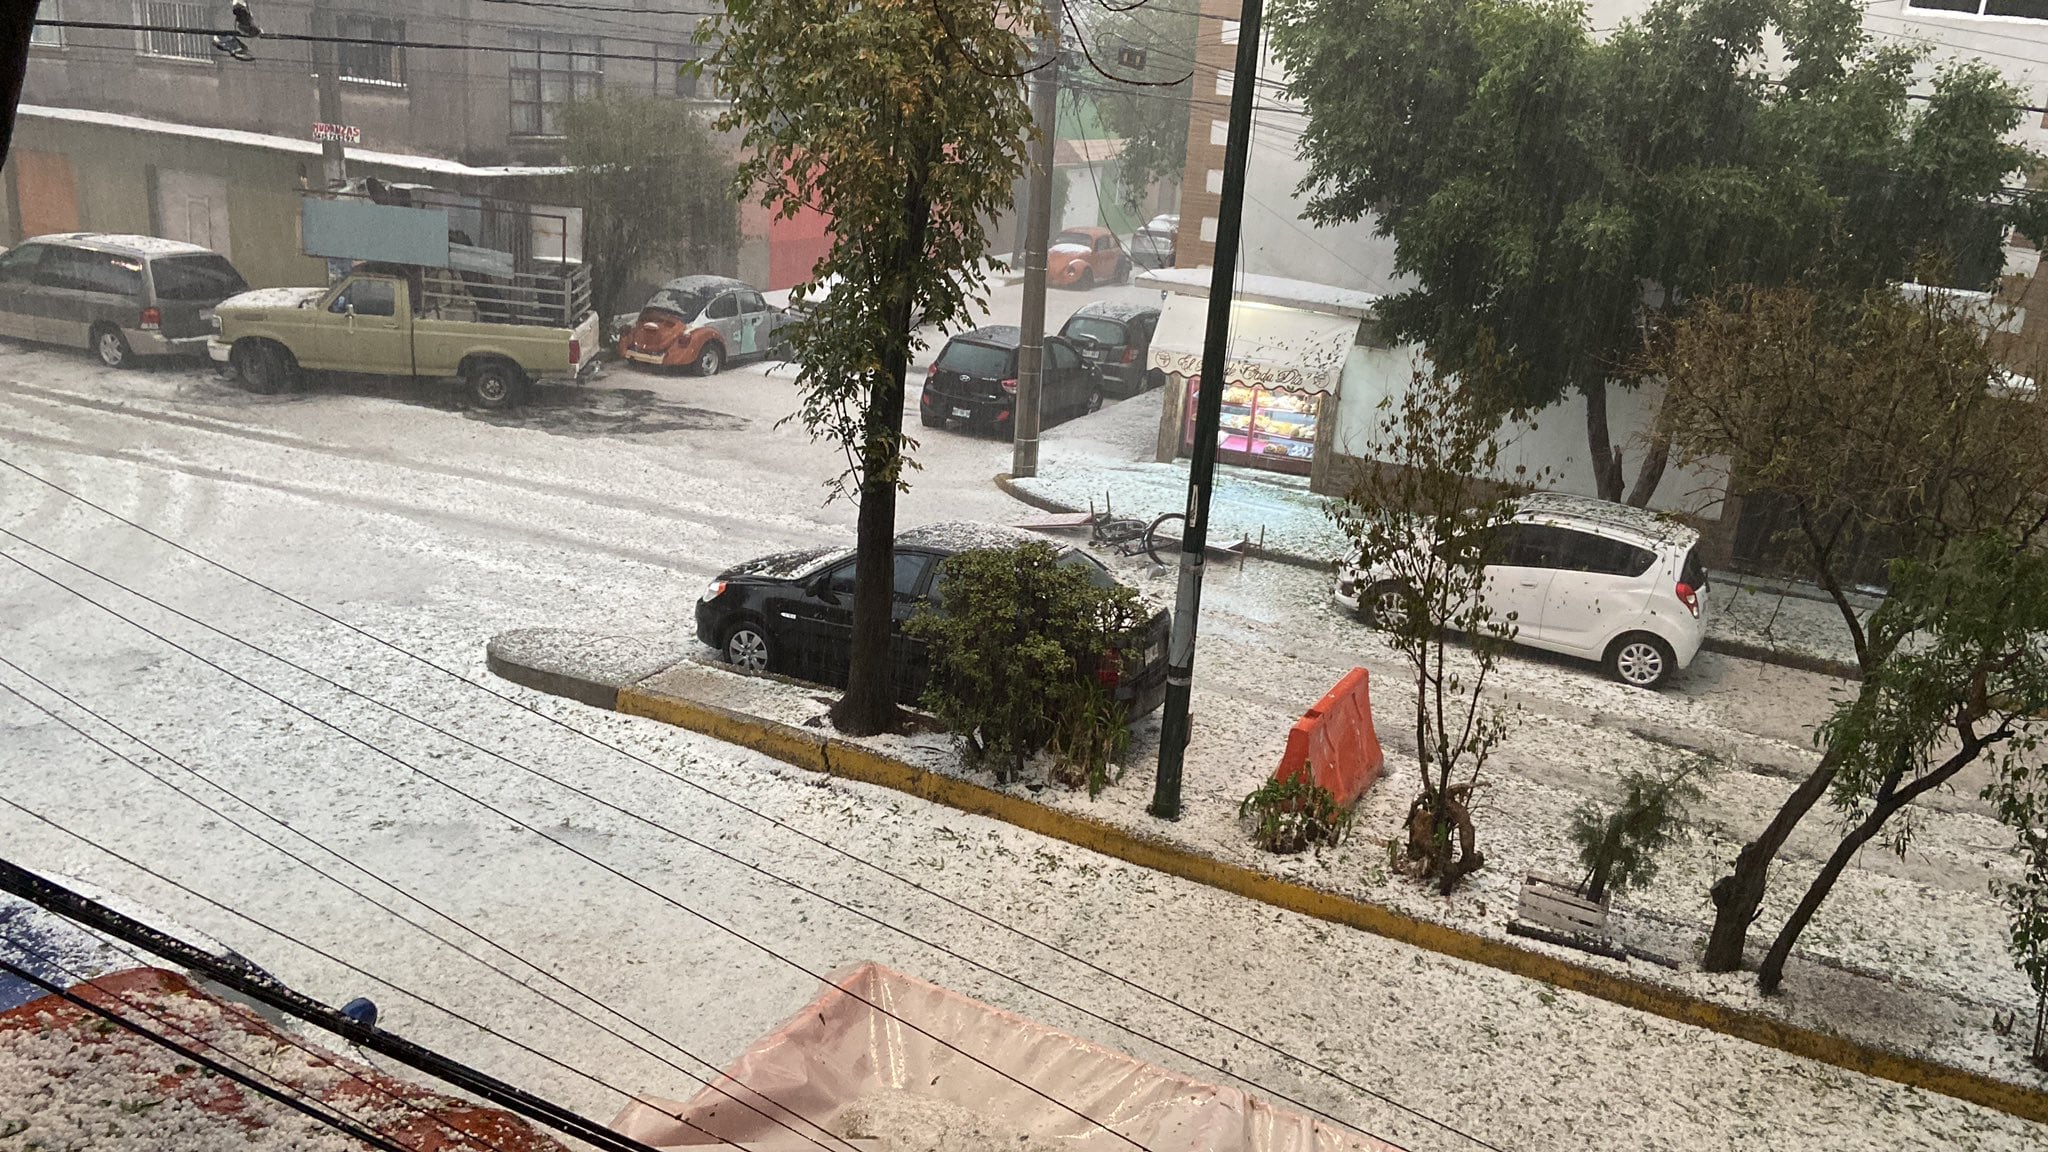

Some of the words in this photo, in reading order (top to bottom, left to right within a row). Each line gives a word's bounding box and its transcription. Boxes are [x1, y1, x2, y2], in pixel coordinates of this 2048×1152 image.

[312, 123, 360, 137] MUDANZAS
[1177, 354, 1196, 372] El
[1240, 363, 1274, 383] Cada
